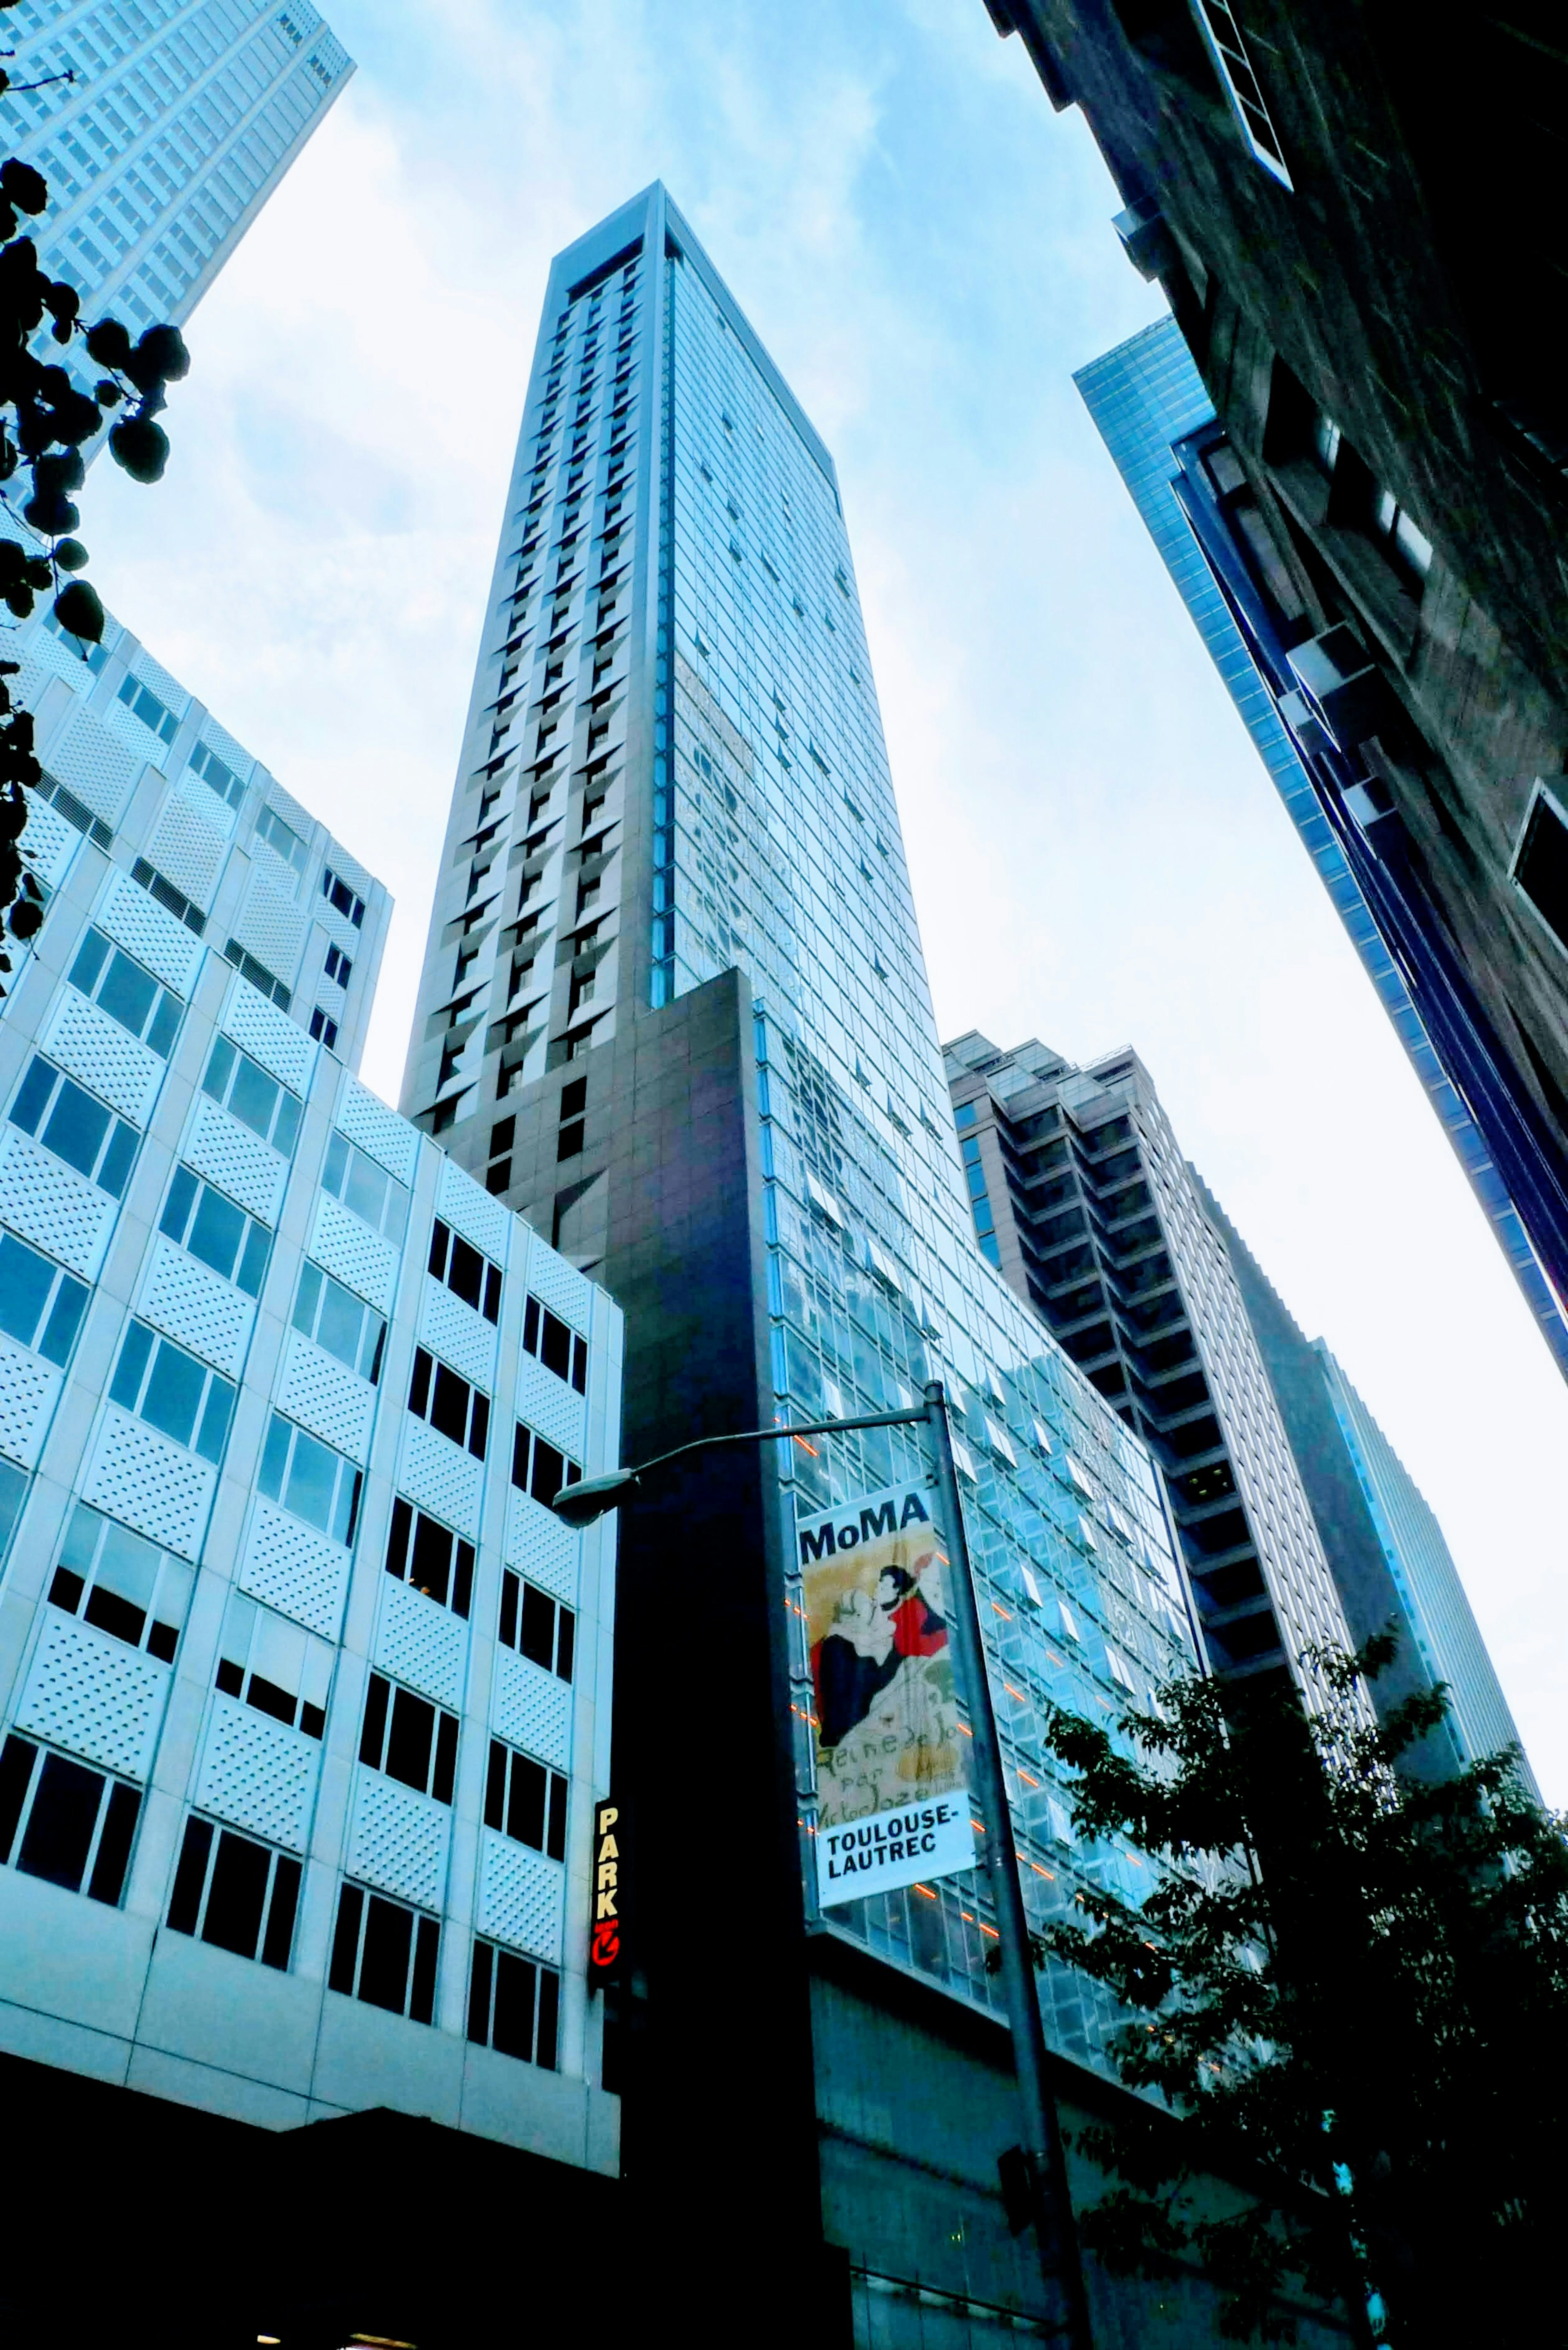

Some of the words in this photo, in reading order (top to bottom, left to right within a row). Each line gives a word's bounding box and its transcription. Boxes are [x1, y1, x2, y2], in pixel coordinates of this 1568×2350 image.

[800, 1492, 930, 1565] MoMA
[827, 1804, 958, 1855] TOULOUSE-
[828, 1833, 936, 1879] LAUTREC
[597, 1807, 619, 1920] PARK
